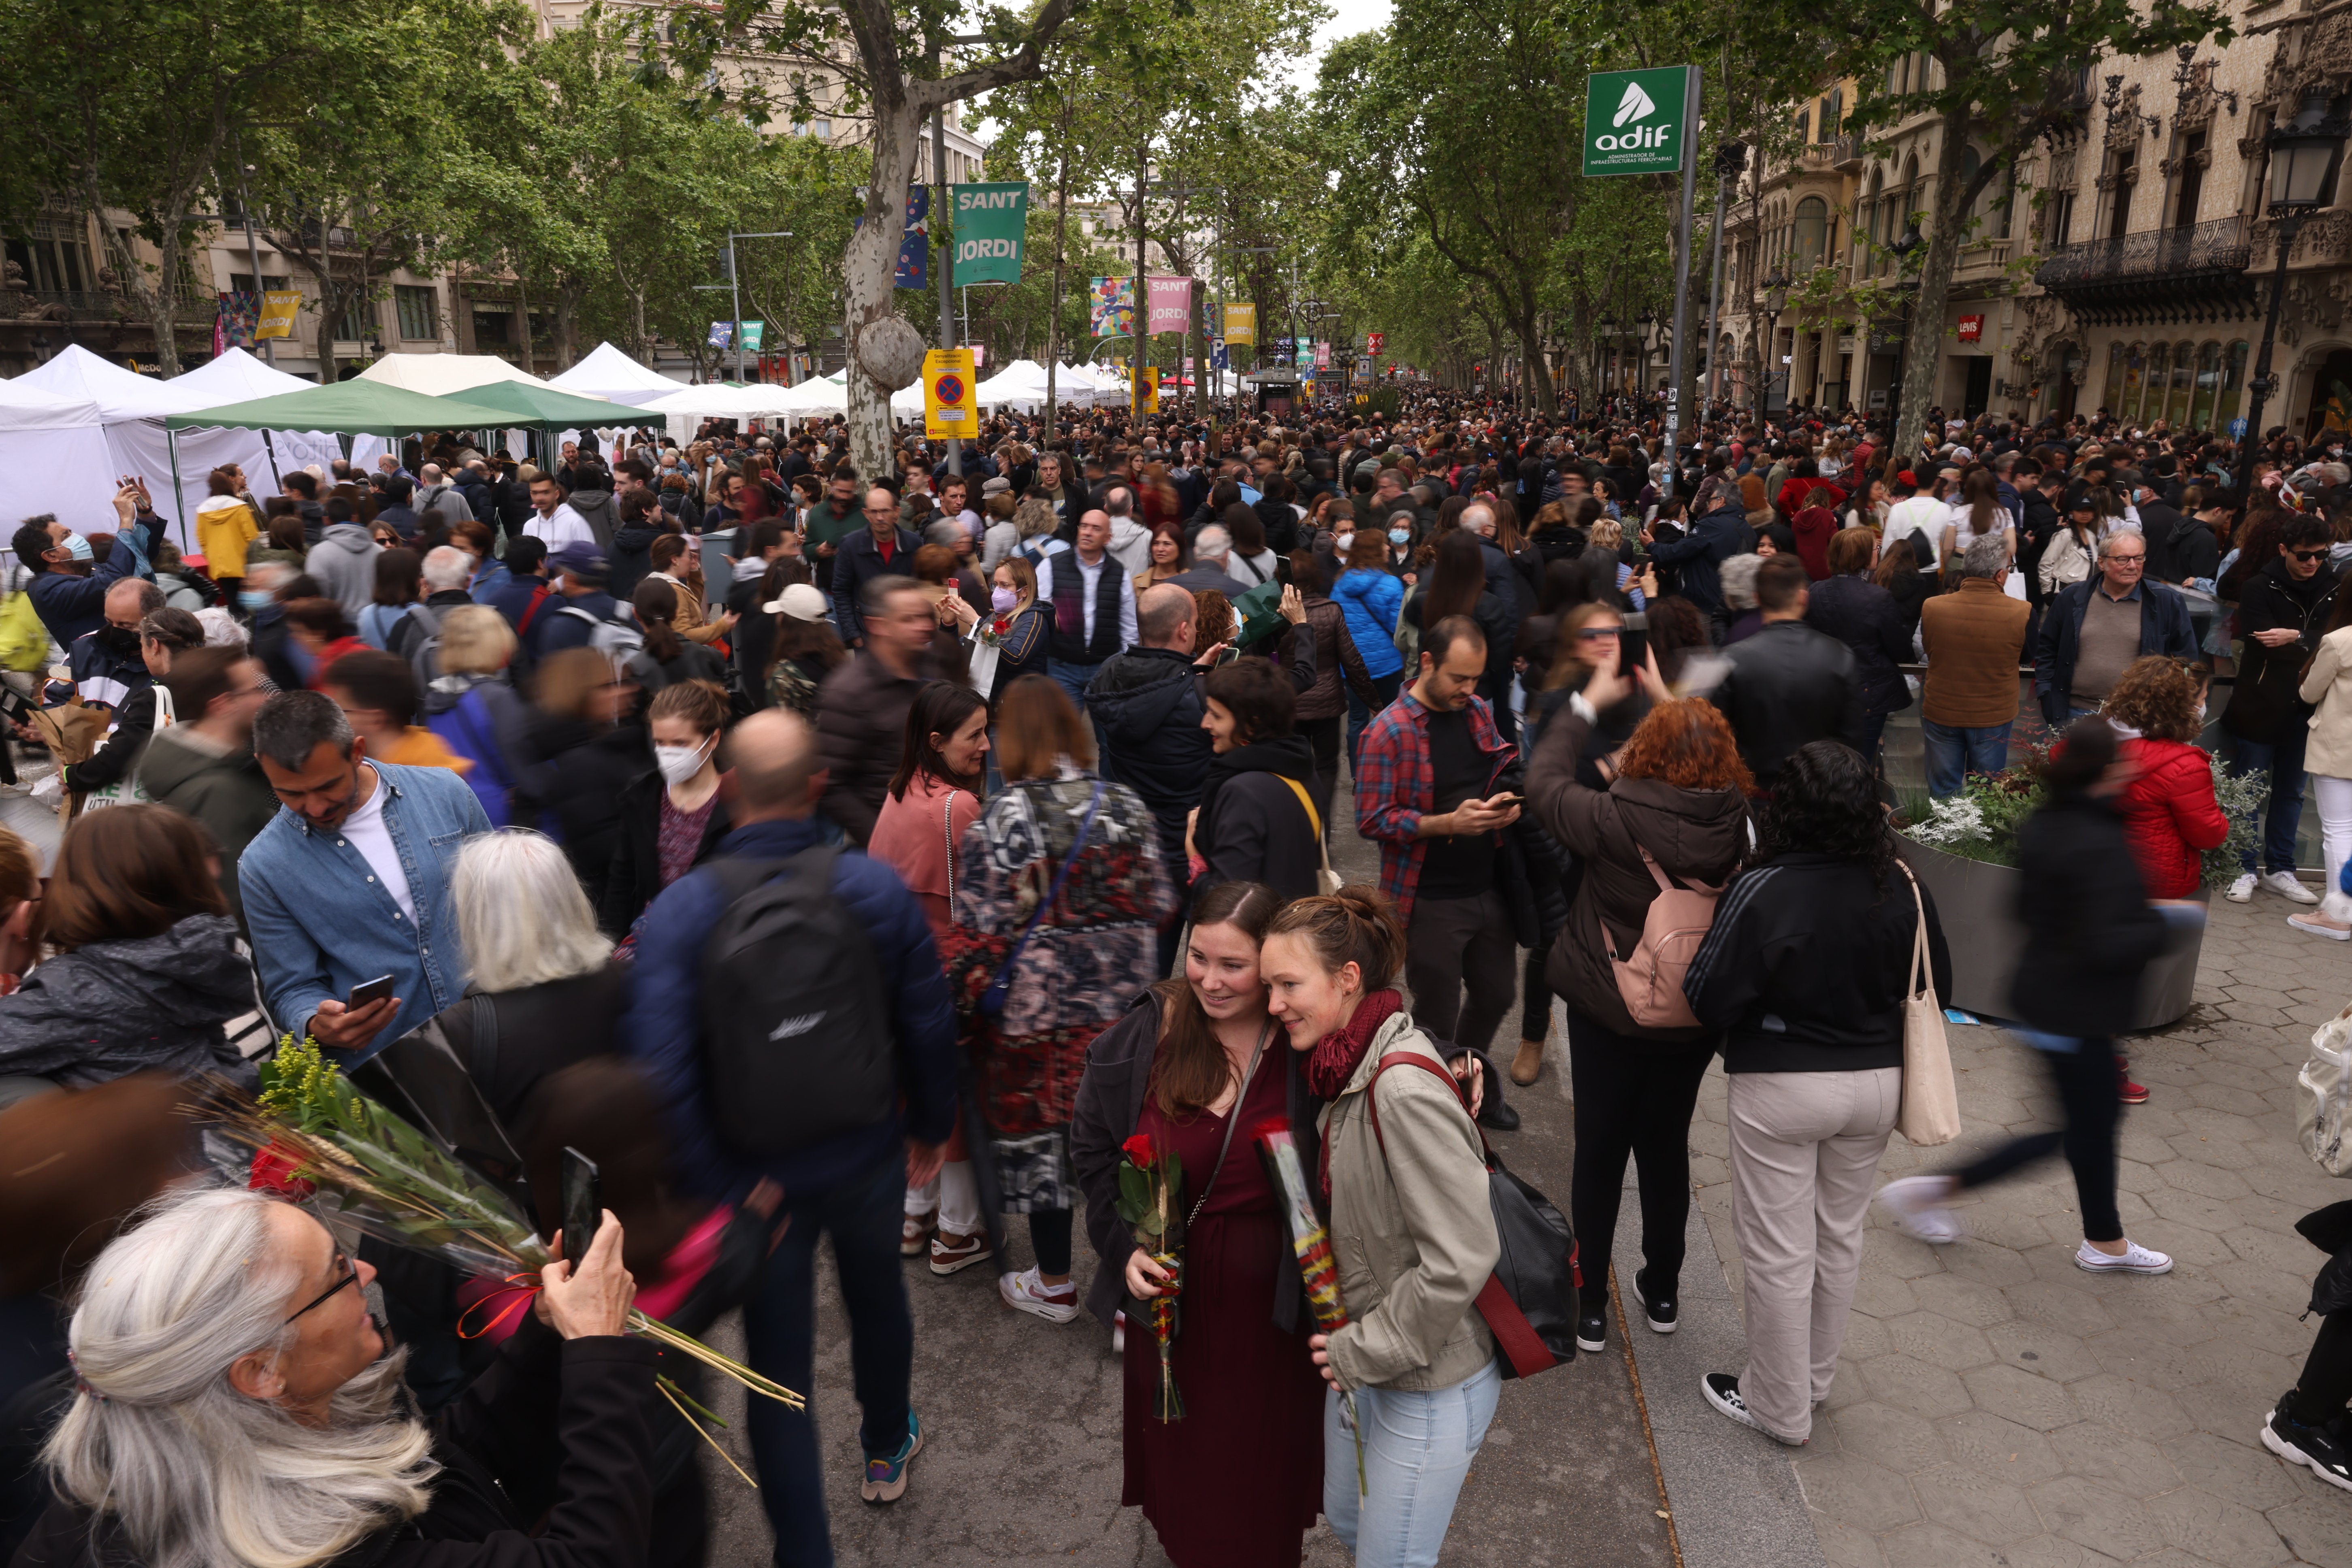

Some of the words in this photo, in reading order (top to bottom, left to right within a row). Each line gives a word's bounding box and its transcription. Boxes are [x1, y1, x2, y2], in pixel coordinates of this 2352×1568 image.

[1596, 124, 1671, 150] adif
[959, 191, 1021, 211] SANT
[956, 239, 1017, 264] JORDI
[1152, 281, 1189, 292] SANT
[268, 295, 299, 305] SANT
[1150, 308, 1187, 321] JORDI
[259, 317, 291, 329] JORDI
[1225, 326, 1251, 335] JORDI
[741, 336, 759, 345] JORDI
[1213, 339, 1225, 356] P
[138, 364, 184, 372] McDo's
[1307, 364, 1314, 373] P
